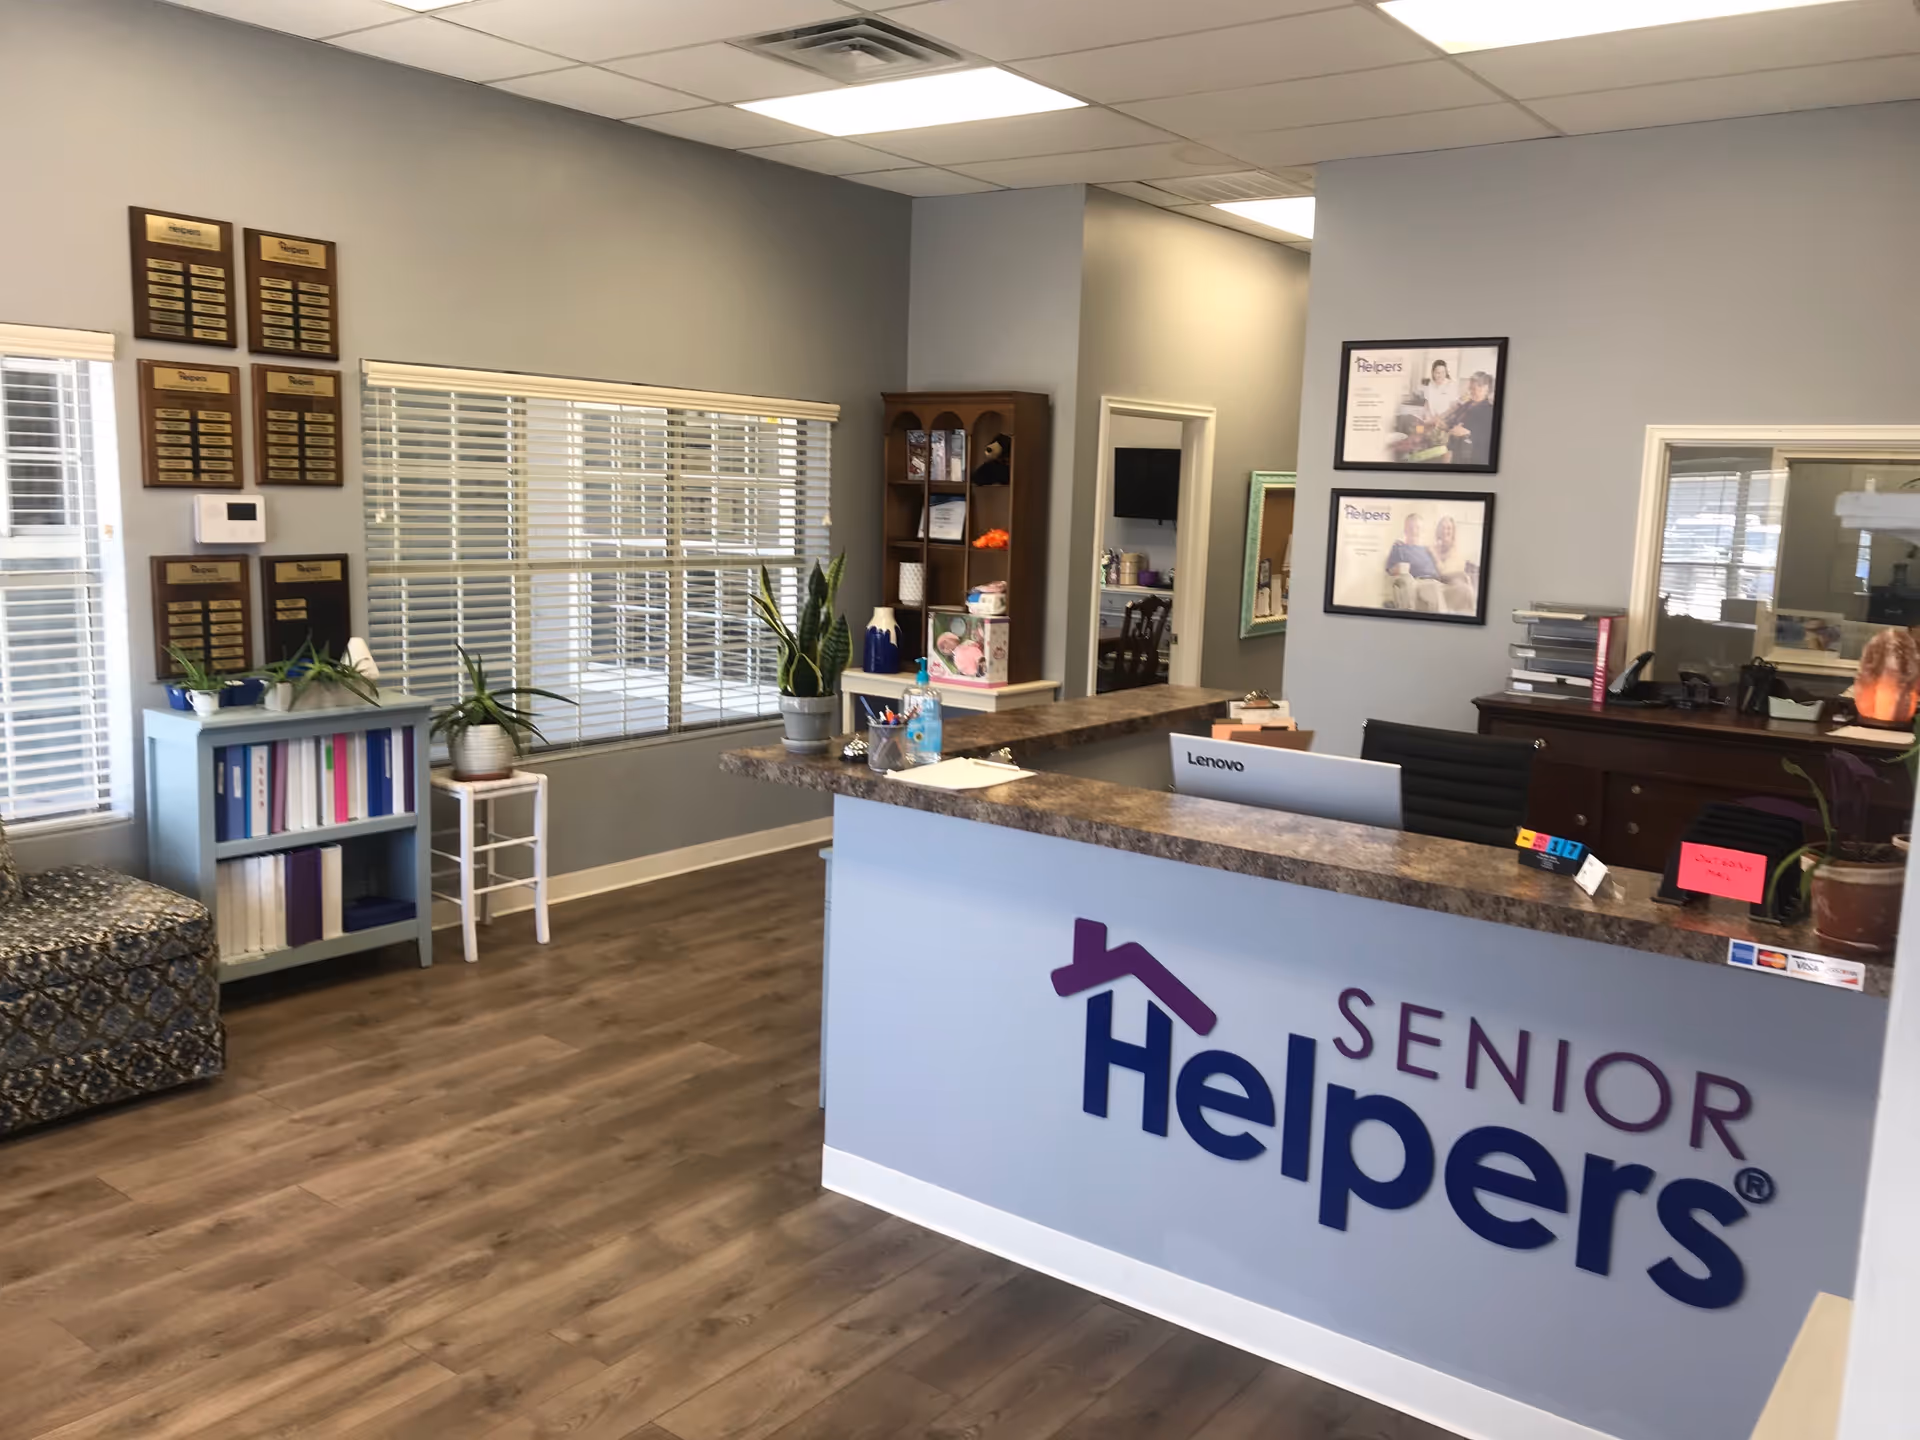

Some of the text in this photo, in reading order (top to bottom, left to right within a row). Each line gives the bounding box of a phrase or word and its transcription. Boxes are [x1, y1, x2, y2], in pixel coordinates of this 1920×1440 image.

[1357, 360, 1402, 374] Helpers
[1346, 508, 1391, 524] Helpers
[1187, 751, 1244, 772] Lenovo
[1795, 960, 1819, 972] VISA
[1332, 987, 1753, 1160] SENIOR
